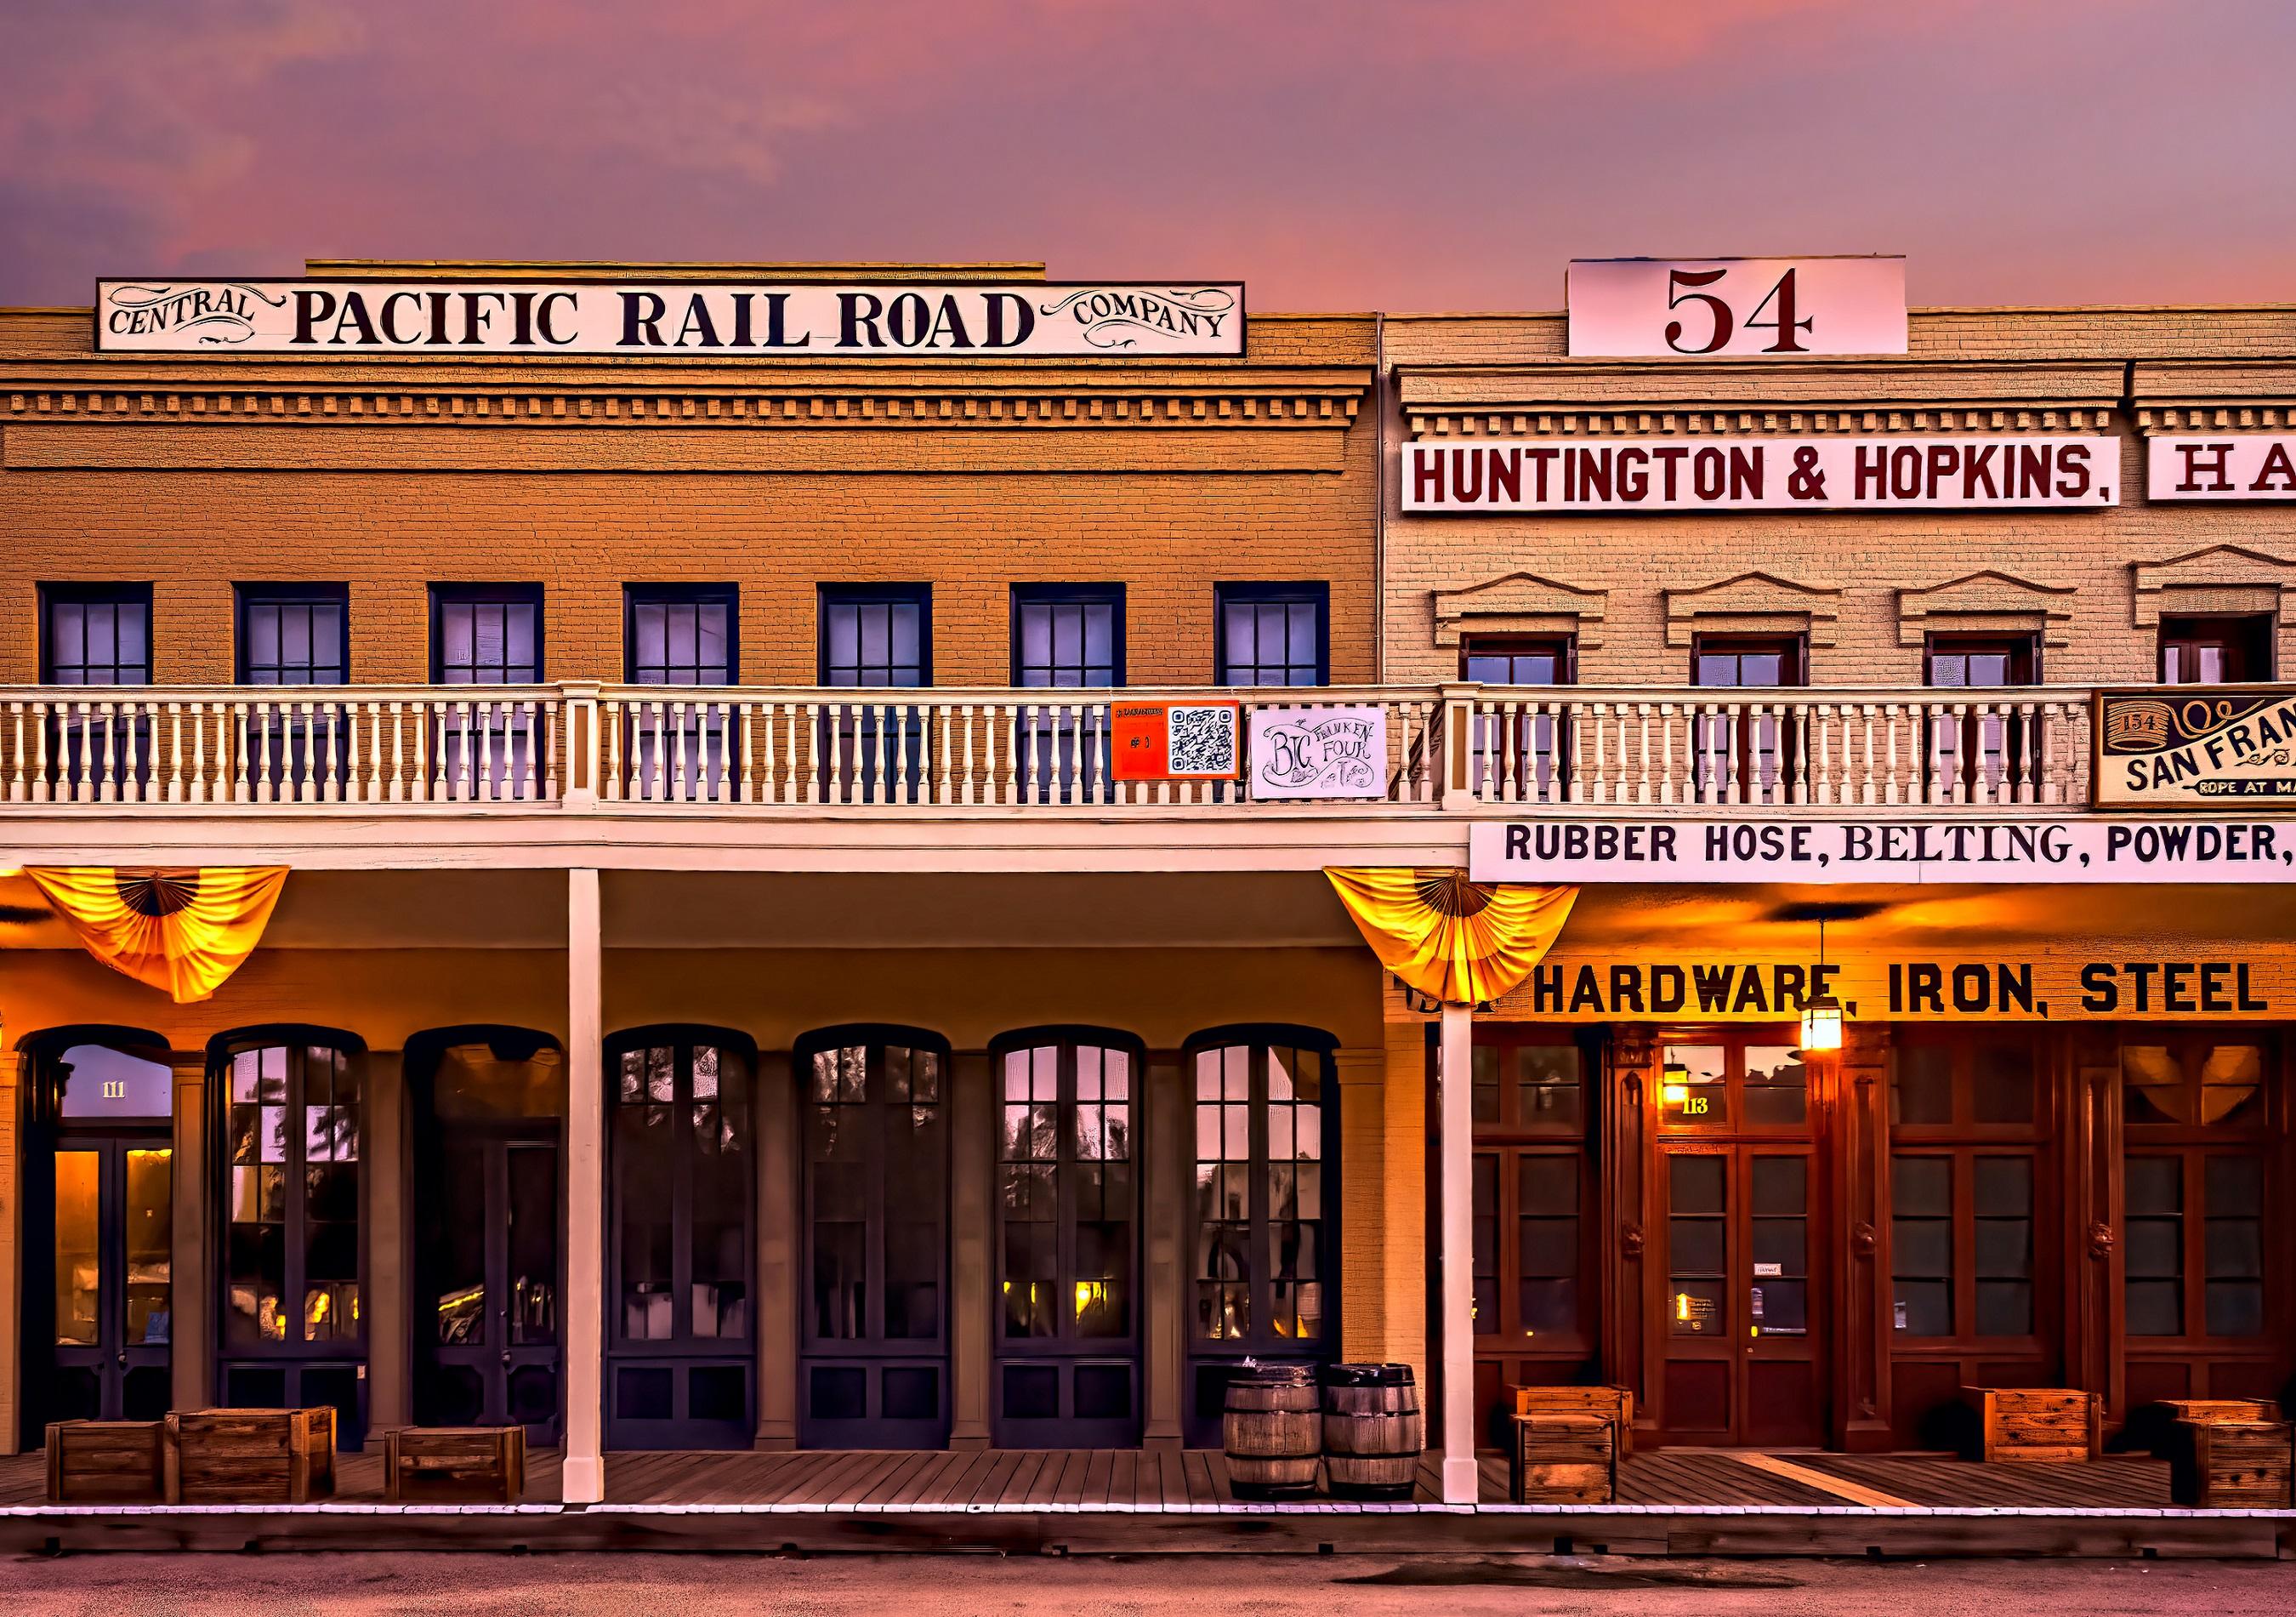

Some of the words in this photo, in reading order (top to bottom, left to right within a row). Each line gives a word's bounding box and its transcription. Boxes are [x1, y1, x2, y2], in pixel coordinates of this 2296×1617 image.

[109, 289, 255, 335] CENTRAL
[289, 291, 578, 345] PACIFIC
[616, 293, 810, 348] RAIL
[833, 293, 1035, 348] ROAD
[1073, 293, 1228, 339] COMPANY
[1664, 268, 1814, 355] 54
[1413, 447, 1764, 504] HUNTINGTON
[1787, 446, 1829, 500] &
[1854, 444, 2110, 503] HOPKINS,
[2174, 443, 2296, 492] HA
[2123, 712, 2157, 731] 154
[1323, 740, 1372, 762] FOUR
[2126, 747, 2201, 791] SAN
[2199, 781, 2237, 794] ROPE
[2243, 781, 2267, 794] AT
[2276, 781, 2296, 794] M
[1505, 824, 1677, 862] RUBBER
[1705, 824, 1829, 868] HOSE,
[1839, 824, 2090, 868] BELTING,
[2107, 824, 2293, 867] POWDER,
[1888, 963, 2049, 1019] IRON,
[2081, 962, 2269, 1013] STEEL
[102, 1080, 126, 1099] 111
[1682, 1096, 1709, 1115] 113
